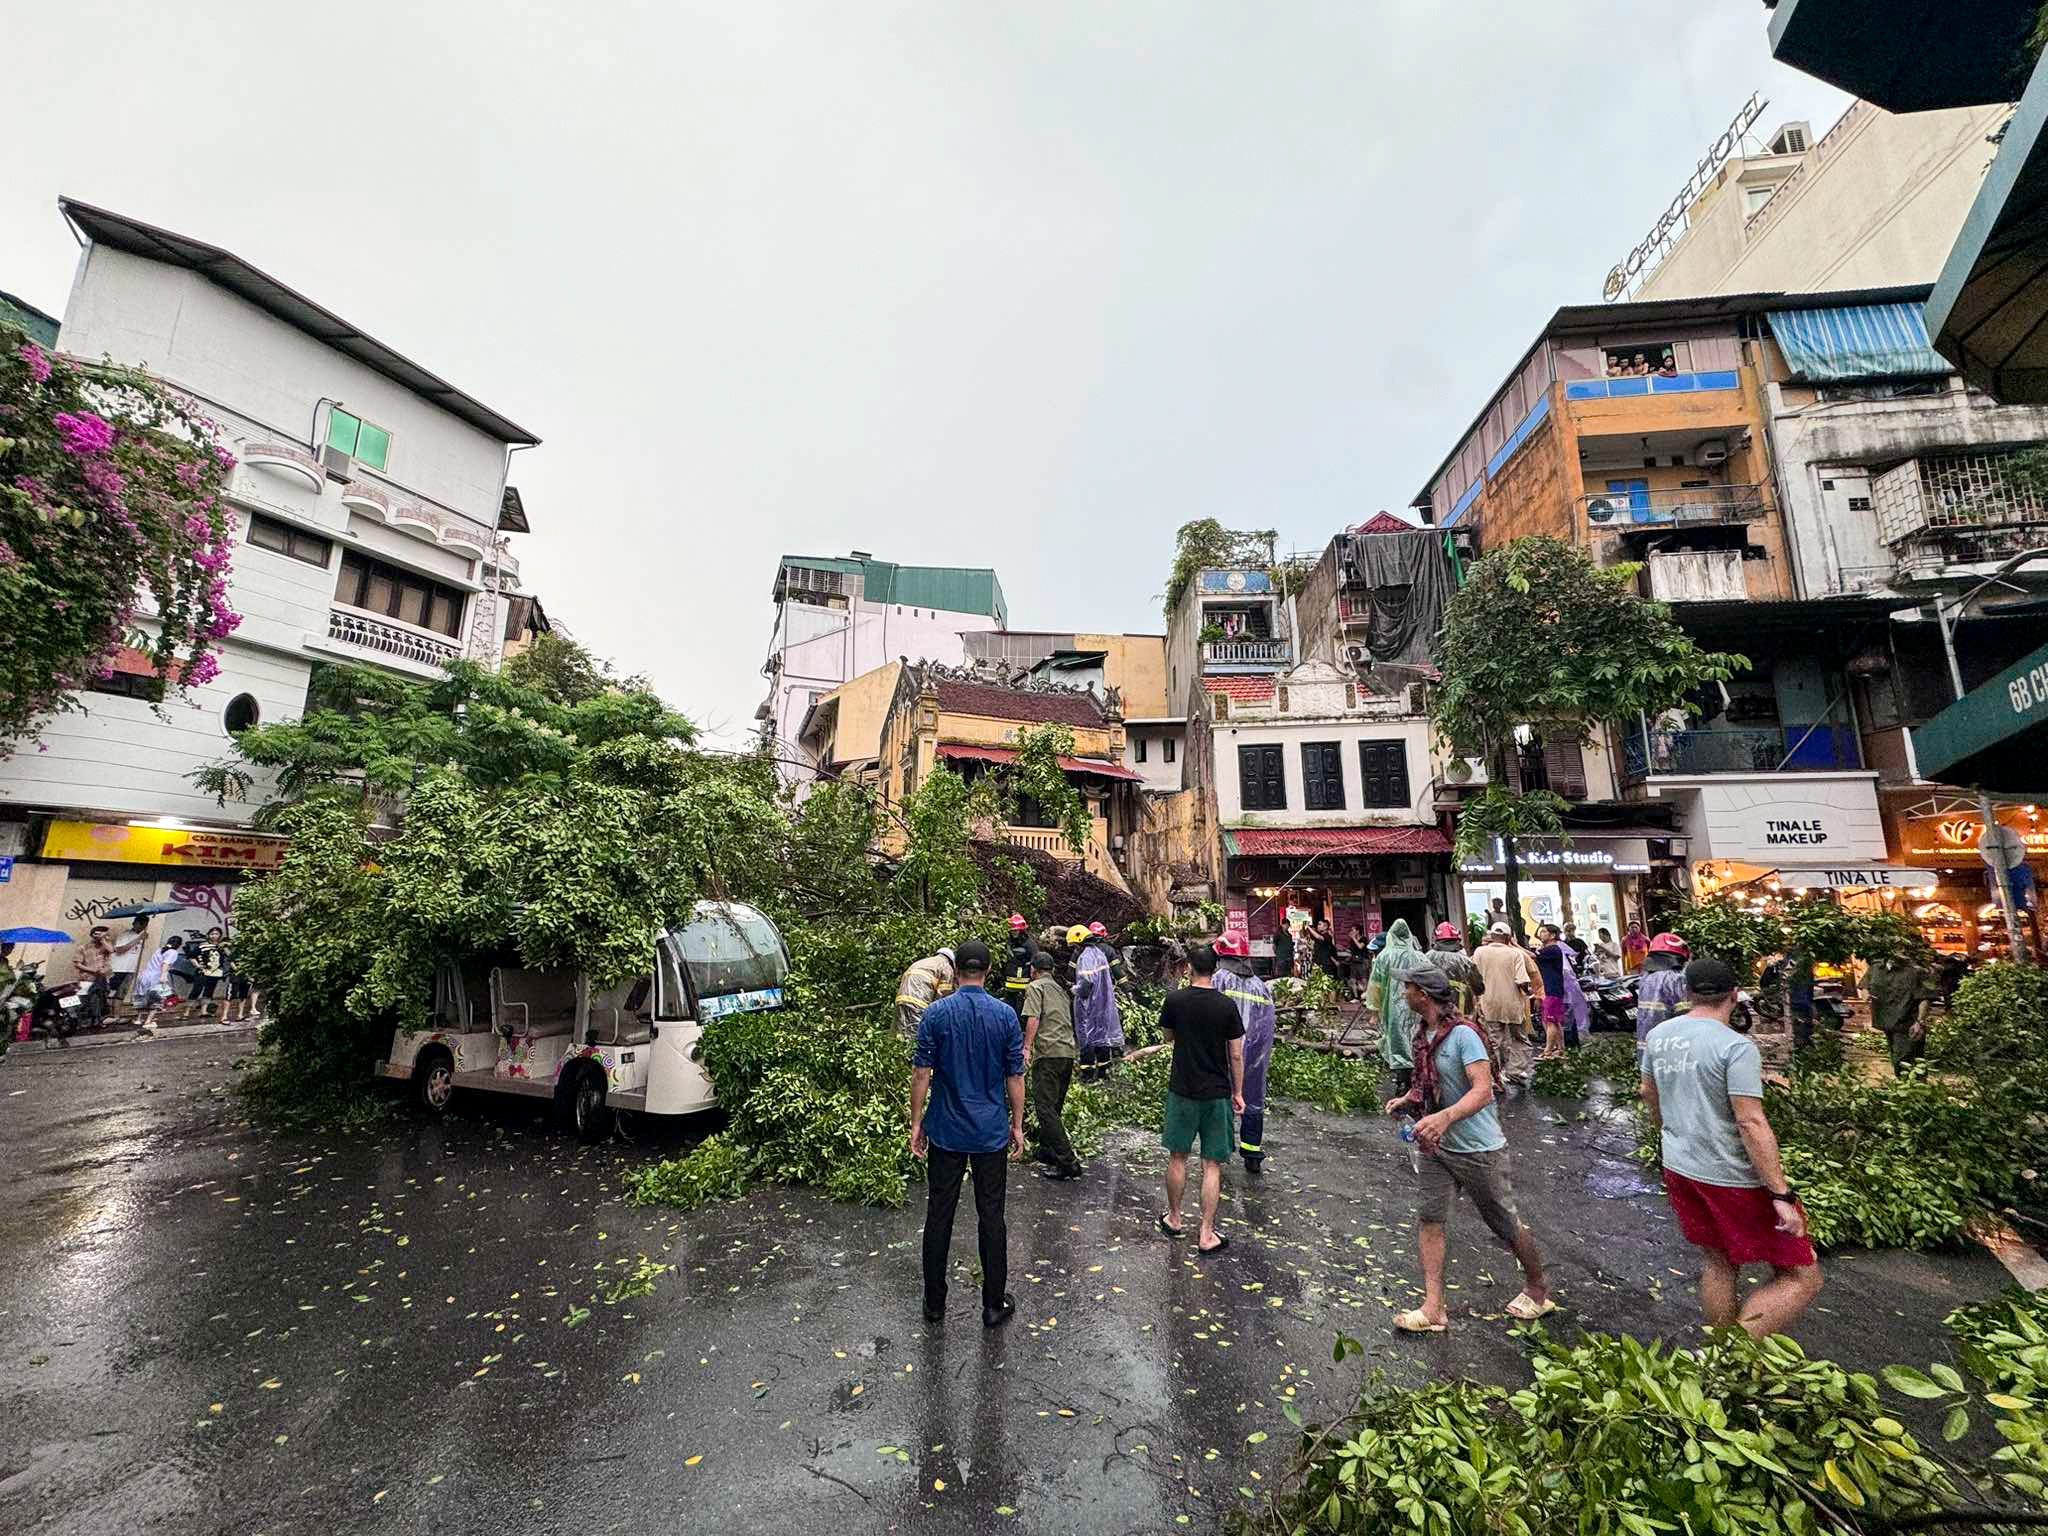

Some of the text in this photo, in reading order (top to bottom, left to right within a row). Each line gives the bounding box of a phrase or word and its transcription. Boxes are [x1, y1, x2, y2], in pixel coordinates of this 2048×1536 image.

[1625, 90, 1763, 277] CHURCH HOTEL
[2007, 676, 2033, 713] 6B
[1766, 820, 1822, 832] TINA LE
[1766, 833, 1828, 844] MAKE UP
[161, 843, 256, 858] KIM
[1562, 850, 1614, 864] Studio
[1824, 871, 1891, 885] TINA LE
